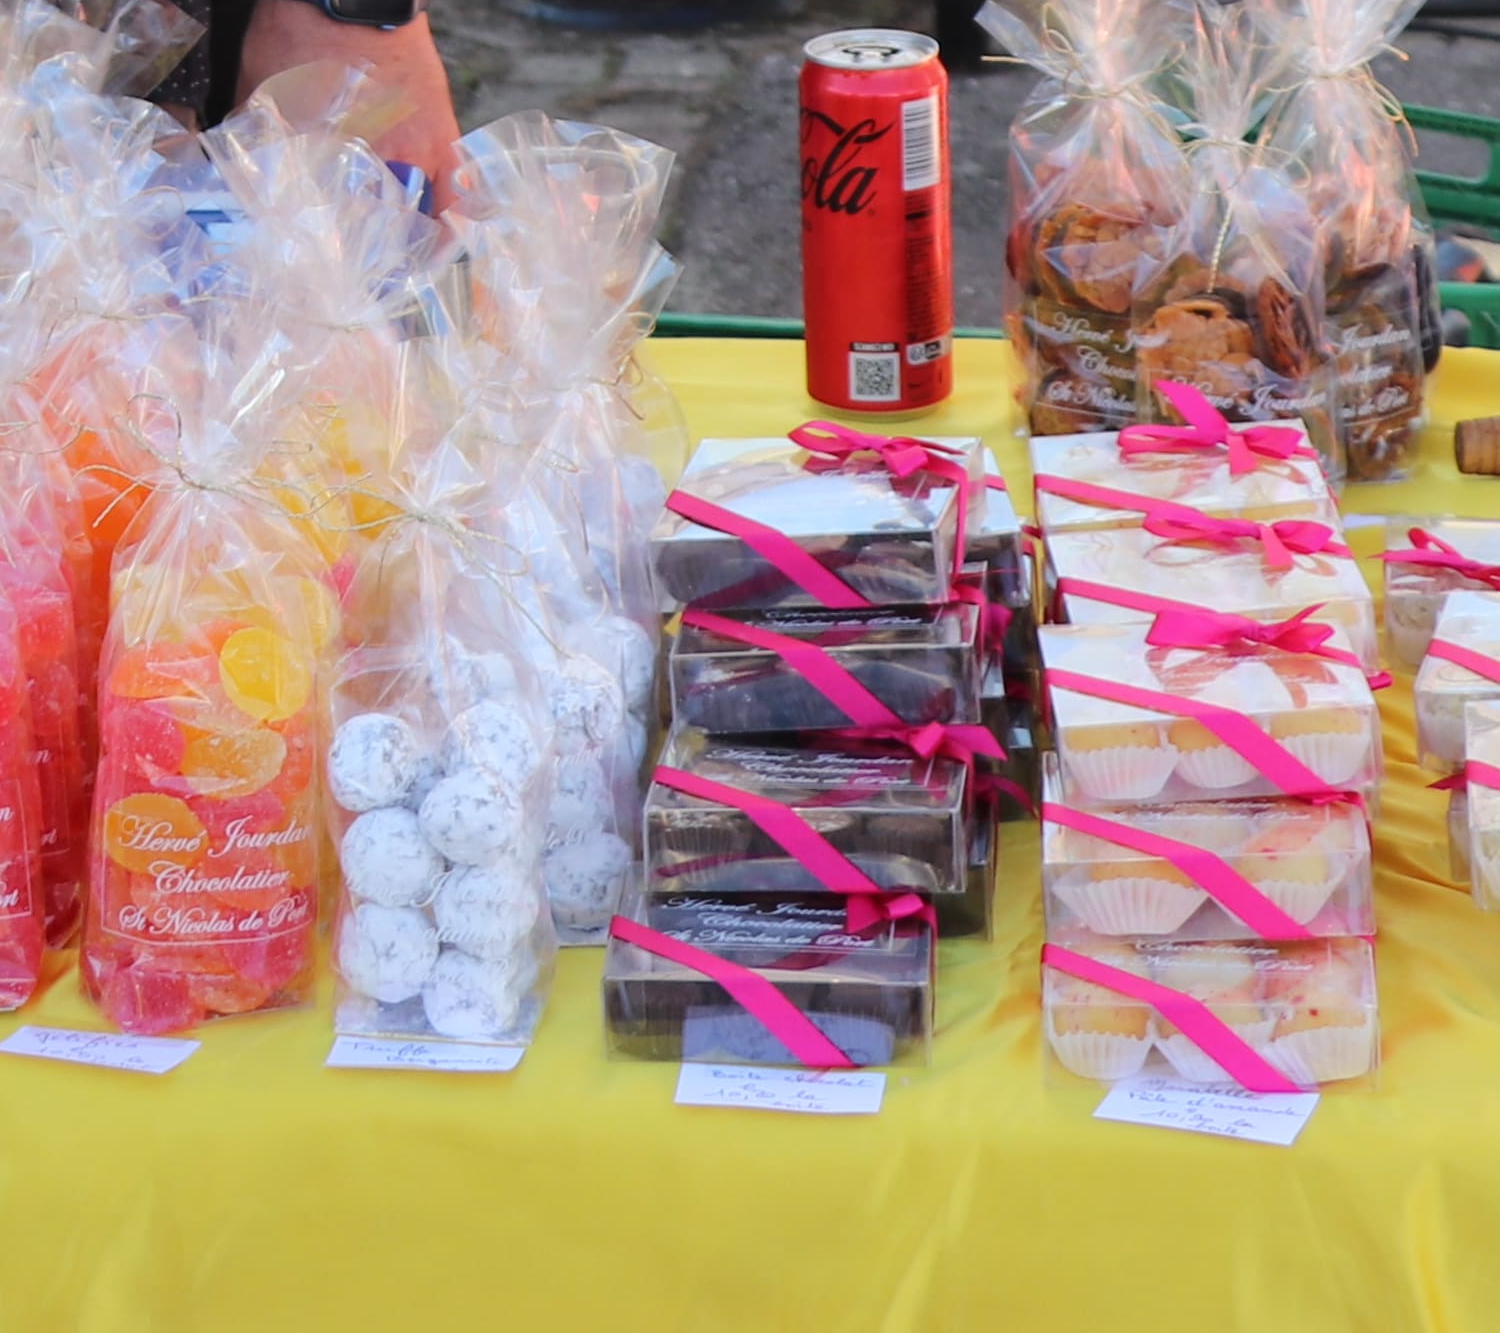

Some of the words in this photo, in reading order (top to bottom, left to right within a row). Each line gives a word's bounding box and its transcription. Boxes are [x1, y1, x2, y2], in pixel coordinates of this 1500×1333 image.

[117, 814, 208, 853] Hervé
[147, 859, 294, 895] Chocolatier
[118, 904, 147, 932] St
[148, 906, 235, 935] Nicolas
[237, 909, 265, 932] de
[755, 901, 848, 916] Jourd
